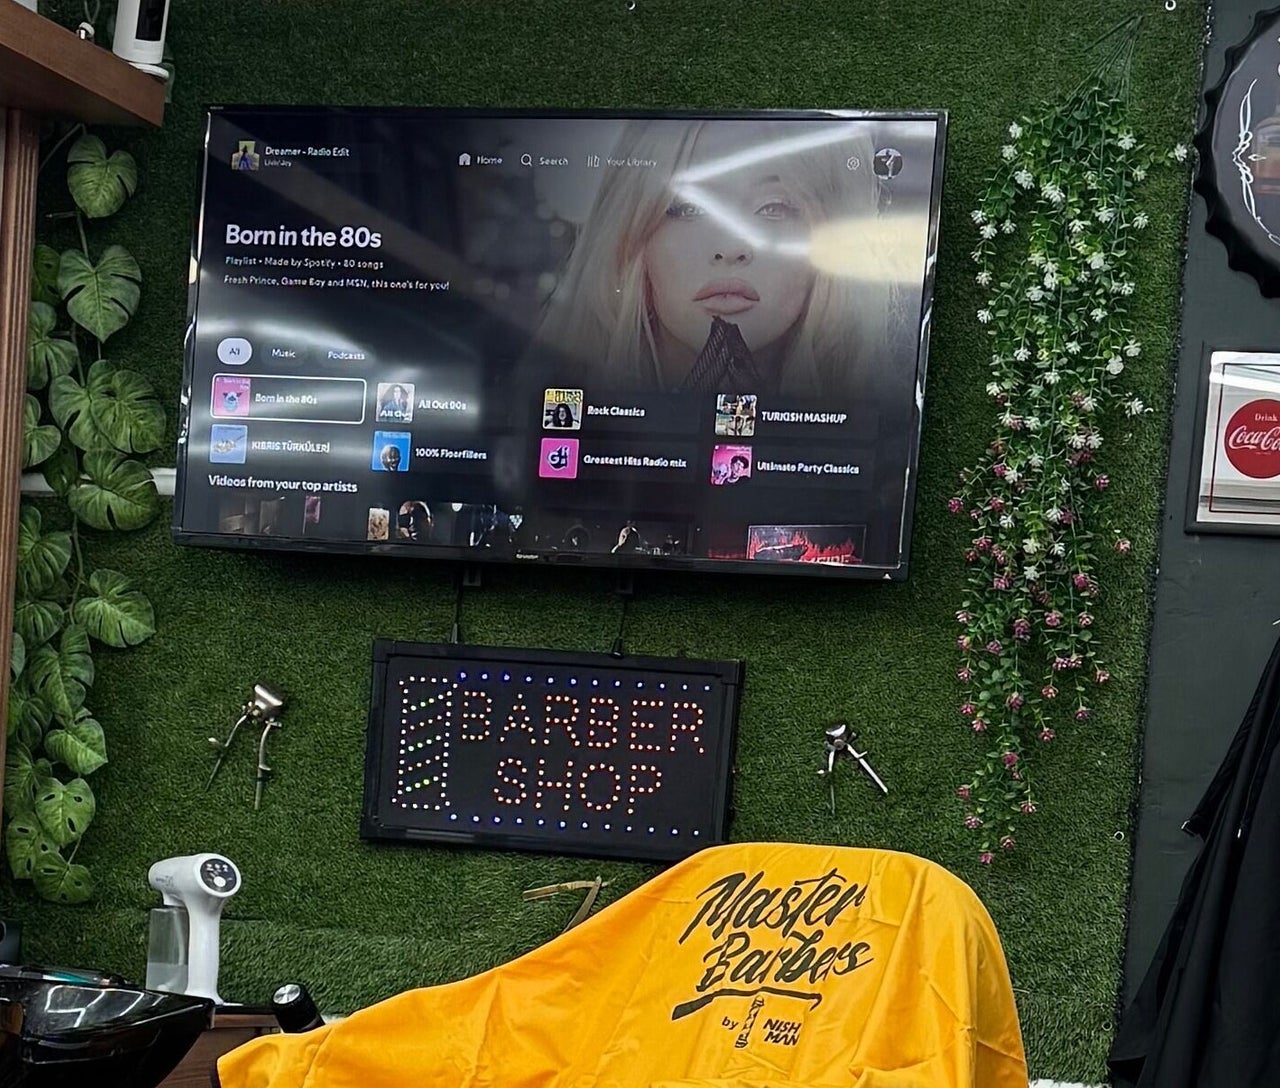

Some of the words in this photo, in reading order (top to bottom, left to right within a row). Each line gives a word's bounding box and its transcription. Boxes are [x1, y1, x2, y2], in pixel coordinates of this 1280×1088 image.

[265, 146, 301, 156] Dreamer
[307, 147, 331, 157] Radio
[477, 155, 502, 164] Home
[539, 156, 569, 166] Search
[627, 157, 657, 168] Library
[226, 224, 276, 245] Born
[278, 225, 297, 246] in
[301, 225, 337, 247] the
[339, 226, 382, 248] 80s
[225, 256, 257, 267] Playlist
[264, 257, 289, 267] Made
[291, 257, 302, 268] by
[303, 258, 335, 269] Spotify
[357, 260, 384, 270] songs
[224, 274, 247, 285] Fresh
[327, 277, 345, 287] and
[371, 279, 388, 289] this
[415, 279, 429, 290] for
[229, 348, 241, 356] All
[271, 348, 296, 358] Music
[328, 350, 366, 360] Podcasts
[255, 393, 276, 403] Born
[276, 394, 284, 403] in
[285, 394, 300, 404] the
[418, 400, 431, 409] All
[431, 400, 448, 410] Out
[587, 405, 609, 415] Rock
[610, 406, 646, 417] Classics
[761, 411, 802, 422] TURKISH
[804, 412, 847, 424] MASHUP
[1255, 413, 1278, 422] Drink
[415, 447, 439, 458] 100%
[440, 448, 487, 460] Floorfillers
[583, 455, 623, 465] Greatest
[624, 456, 642, 466] Hits
[642, 457, 669, 467] Radio
[669, 458, 687, 468] mix
[757, 461, 797, 472] Ultimate
[797, 463, 823, 475] Party
[823, 464, 860, 475] Classics
[208, 474, 247, 487] Videos
[247, 476, 274, 489] from
[275, 480, 301, 491] your
[302, 481, 321, 493] top
[322, 480, 358, 493] artists
[461, 690, 704, 755] BARBER
[493, 757, 662, 815] SHOP
[678, 867, 869, 945] Master
[721, 1016, 739, 1031] by
[763, 1018, 802, 1034] NISH
[764, 1031, 800, 1046] MAN
